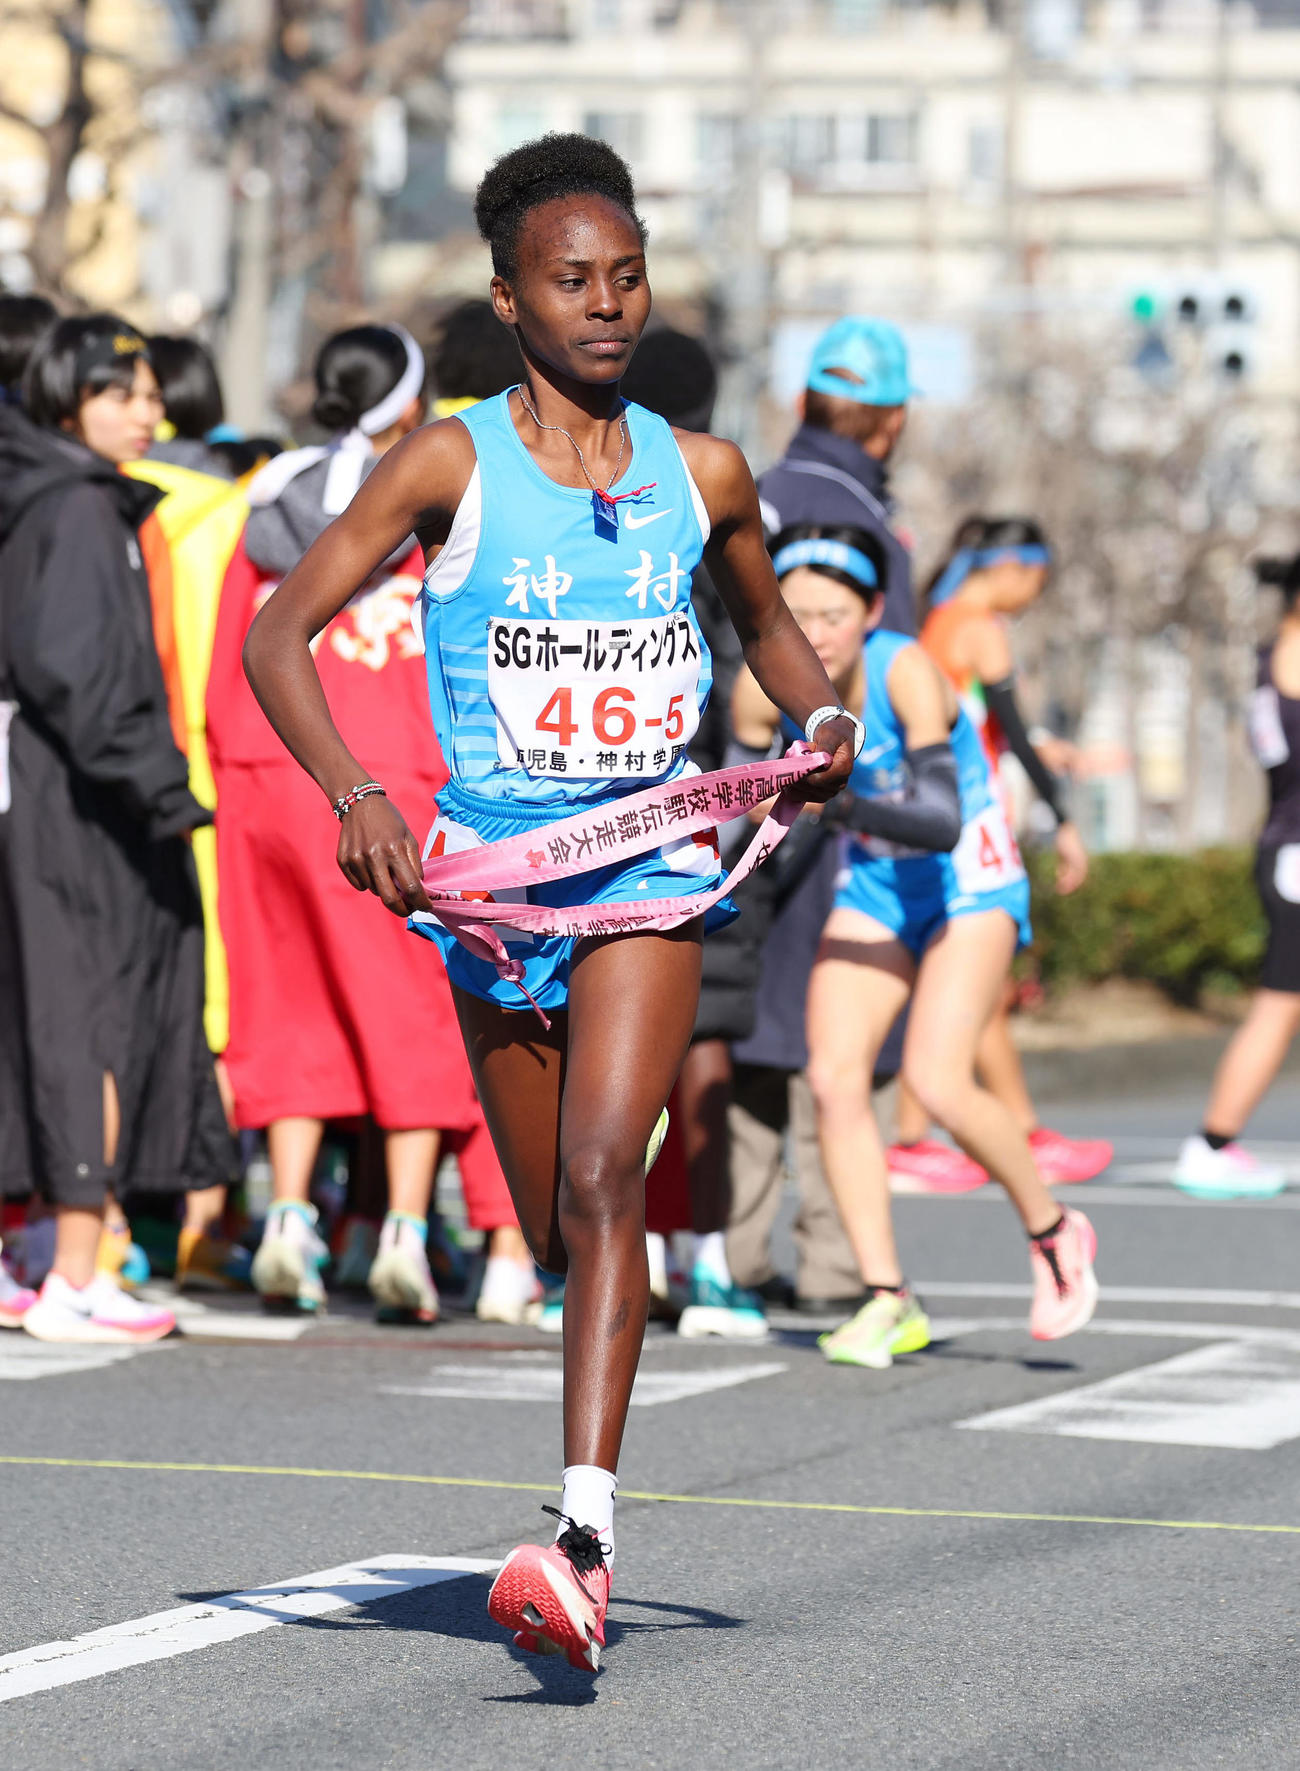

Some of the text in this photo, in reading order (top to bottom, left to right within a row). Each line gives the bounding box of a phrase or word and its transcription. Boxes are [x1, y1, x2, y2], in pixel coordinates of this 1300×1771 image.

[501, 549, 686, 618] 神村
[493, 619, 698, 673] SGホールディングス
[535, 686, 684, 746] 46-5
